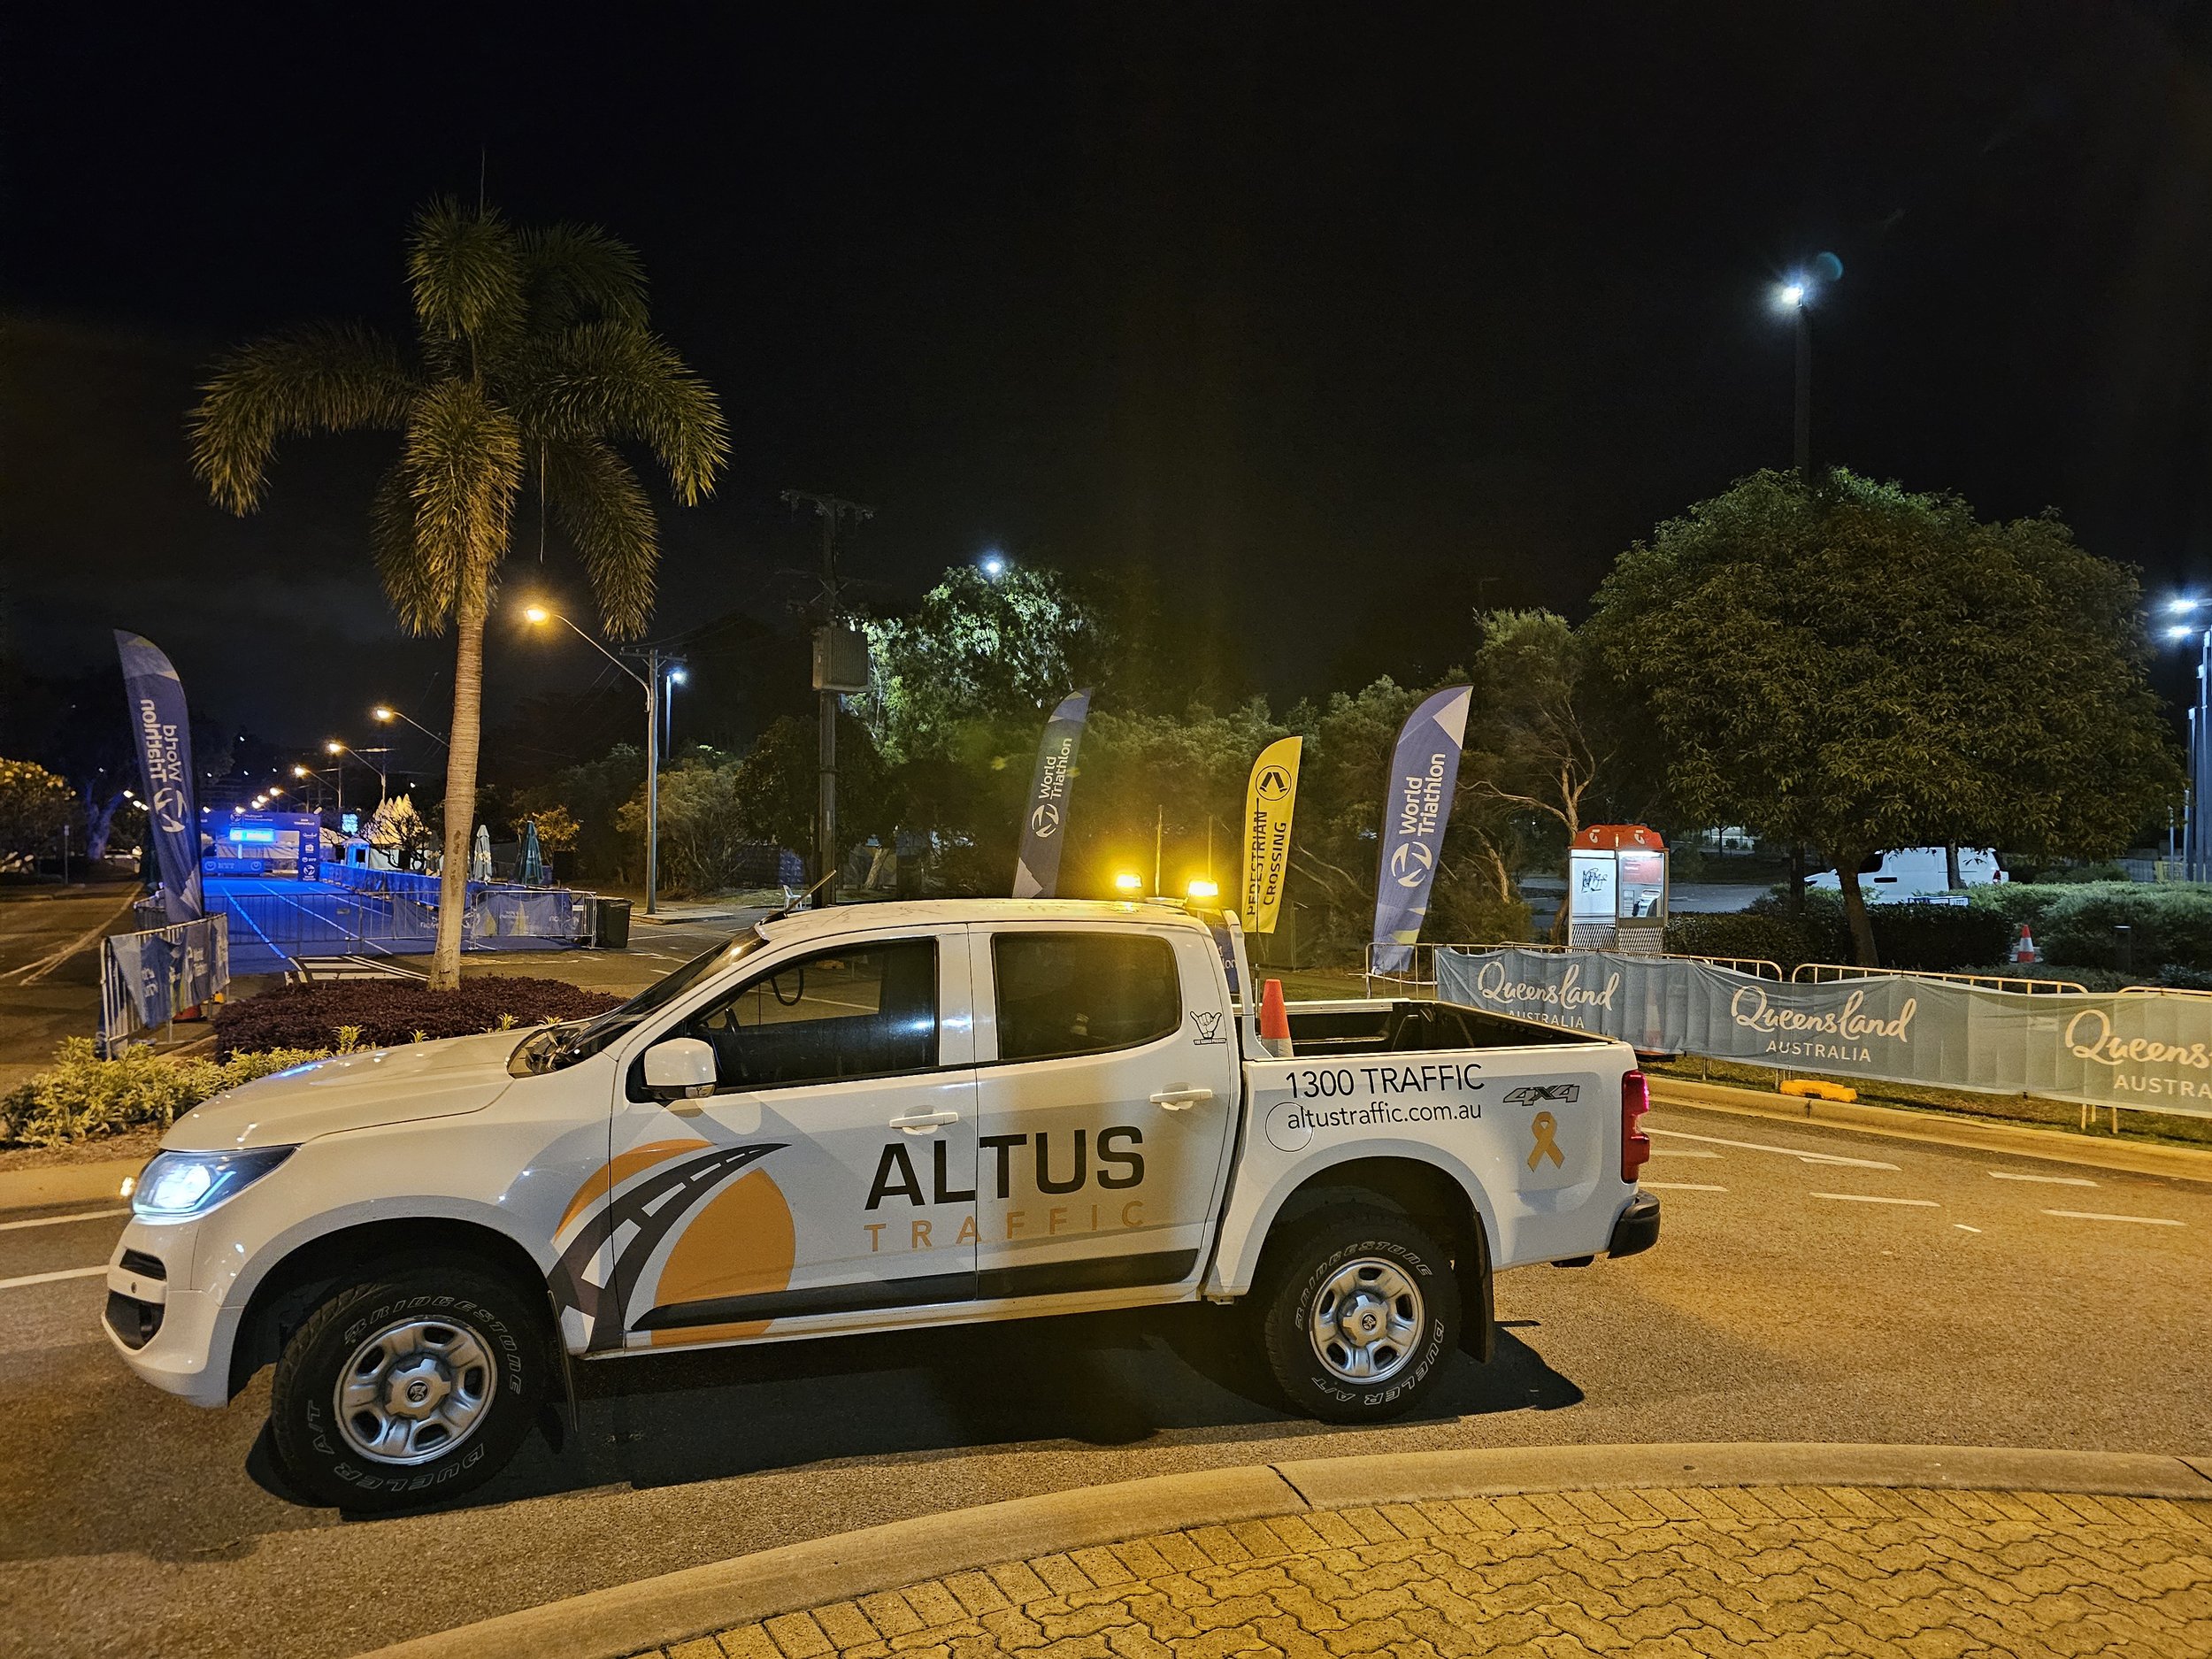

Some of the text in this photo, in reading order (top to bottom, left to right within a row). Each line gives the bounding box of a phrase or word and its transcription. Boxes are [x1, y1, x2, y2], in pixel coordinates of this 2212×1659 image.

[1038, 756, 1056, 799] World
[1049, 737, 1073, 800] Triathlon
[1417, 753, 1446, 837] Triathlon
[1398, 776, 1423, 834] World
[1247, 811, 1268, 916] PEDESTRIAN
[1263, 821, 1286, 906] CROSSING
[1478, 960, 1620, 1011] Queensland
[1731, 985, 1917, 1043] Queensland
[1765, 1040, 1871, 1063] AUSTRALIA
[2064, 1009, 2212, 1069] Queens
[1286, 1063, 1485, 1099] 1300 TRAFFIC
[1286, 1101, 1482, 1131] altustraffic.com.au
[864, 1125, 1145, 1211] ALTUS
[863, 1200, 1145, 1253] TRAFFIC
[1294, 1240, 1433, 1332] BRIDGESTONE
[343, 1295, 522, 1395] BRIDGESTONE
[1311, 1318, 1445, 1406] DUELER A/T
[307, 1400, 485, 1493] DUELER A/T
